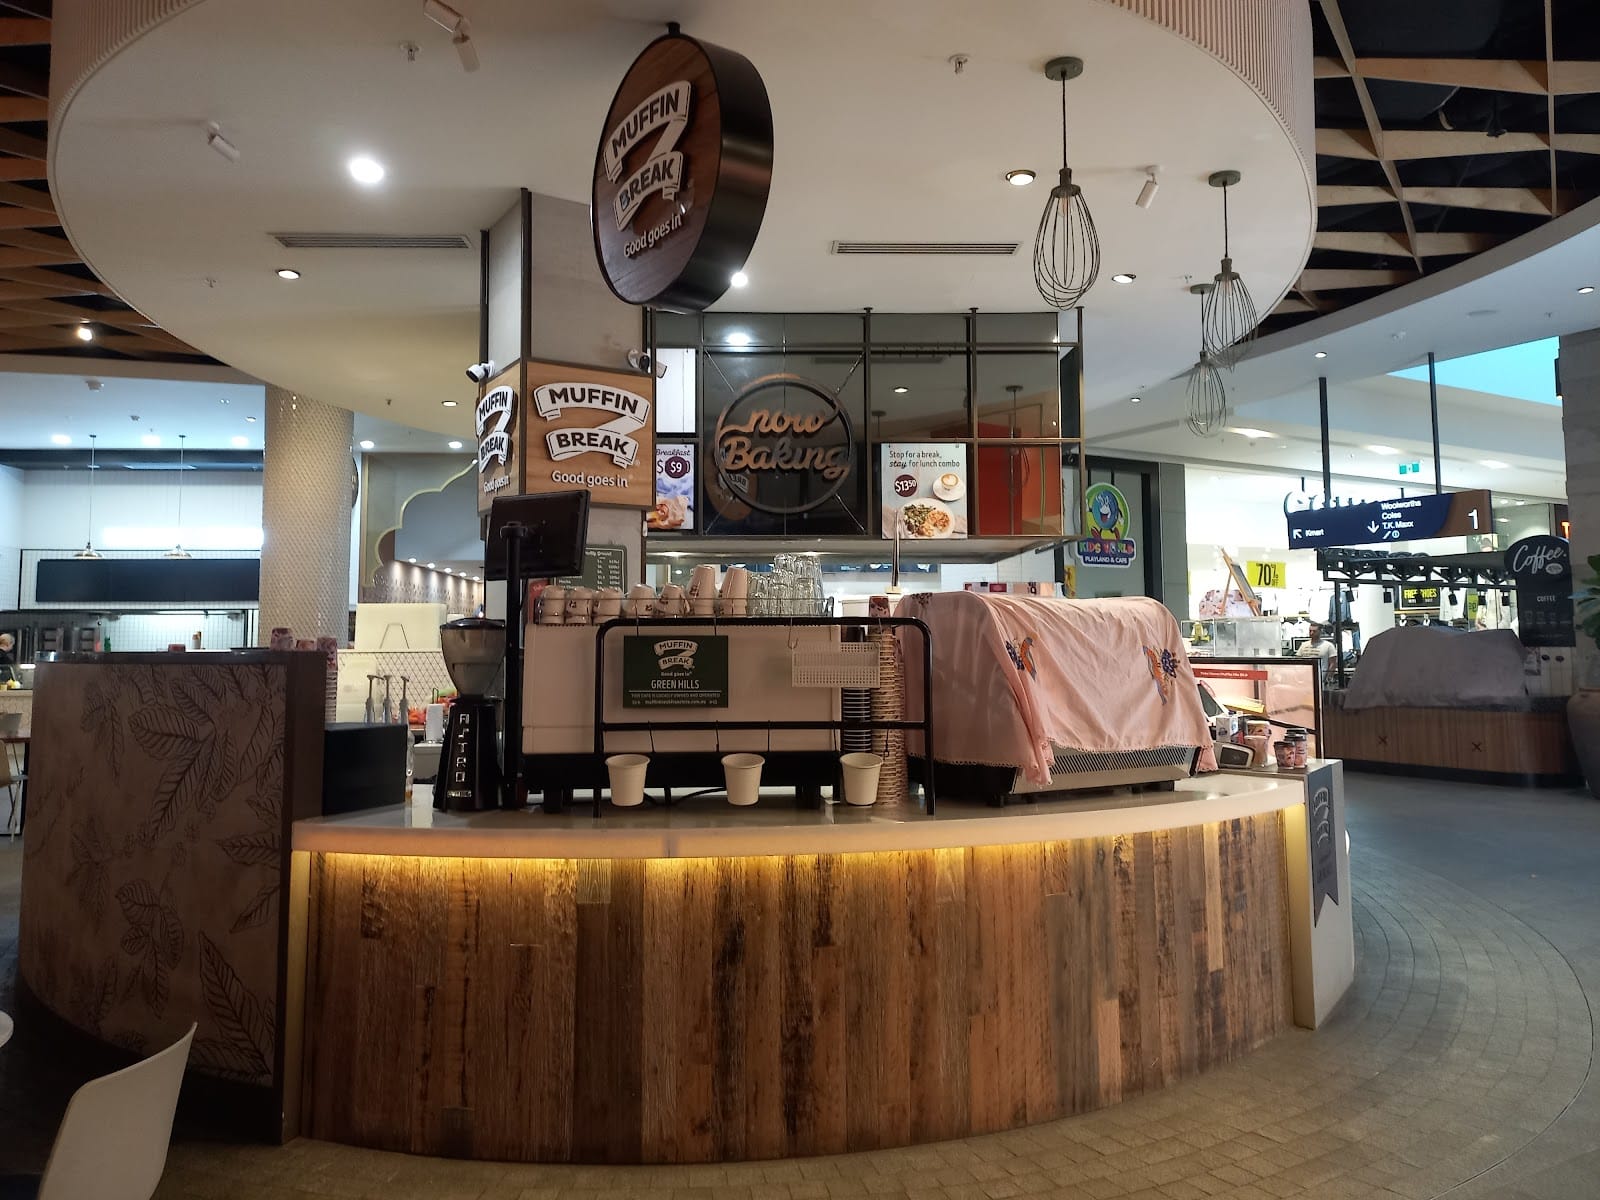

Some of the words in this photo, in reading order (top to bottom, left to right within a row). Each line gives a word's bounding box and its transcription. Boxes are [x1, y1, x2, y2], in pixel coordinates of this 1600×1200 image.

[612, 88, 680, 158] MUFFIN
[619, 157, 676, 211] BREAK
[624, 229, 647, 257] Good
[648, 219, 670, 248] goes
[671, 212, 682, 231] in
[478, 391, 508, 422] MUFFIN
[548, 387, 639, 415] MUFFIN
[738, 406, 830, 433] now
[480, 436, 504, 461] BREAK
[556, 432, 629, 455] BREAK
[724, 436, 848, 480] Baking
[889, 450, 904, 459] Stop
[905, 450, 915, 458] for
[889, 460, 907, 469] stay
[939, 460, 960, 468] combo
[670, 461, 682, 473] $9
[552, 470, 584, 484] Good
[587, 474, 614, 488] goes
[616, 474, 628, 488] in
[1381, 500, 1422, 510] Woolworths
[1381, 511, 1402, 520] Coles
[1467, 508, 1479, 530] 1
[1305, 528, 1325, 537] Kmart
[1079, 541, 1102, 554] KIDS
[1512, 544, 1564, 575] Coffee
[659, 641, 693, 650] MUFFIN
[662, 657, 690, 665] BREAK
[651, 679, 677, 689] GREEN
[678, 679, 700, 689] HILLS
